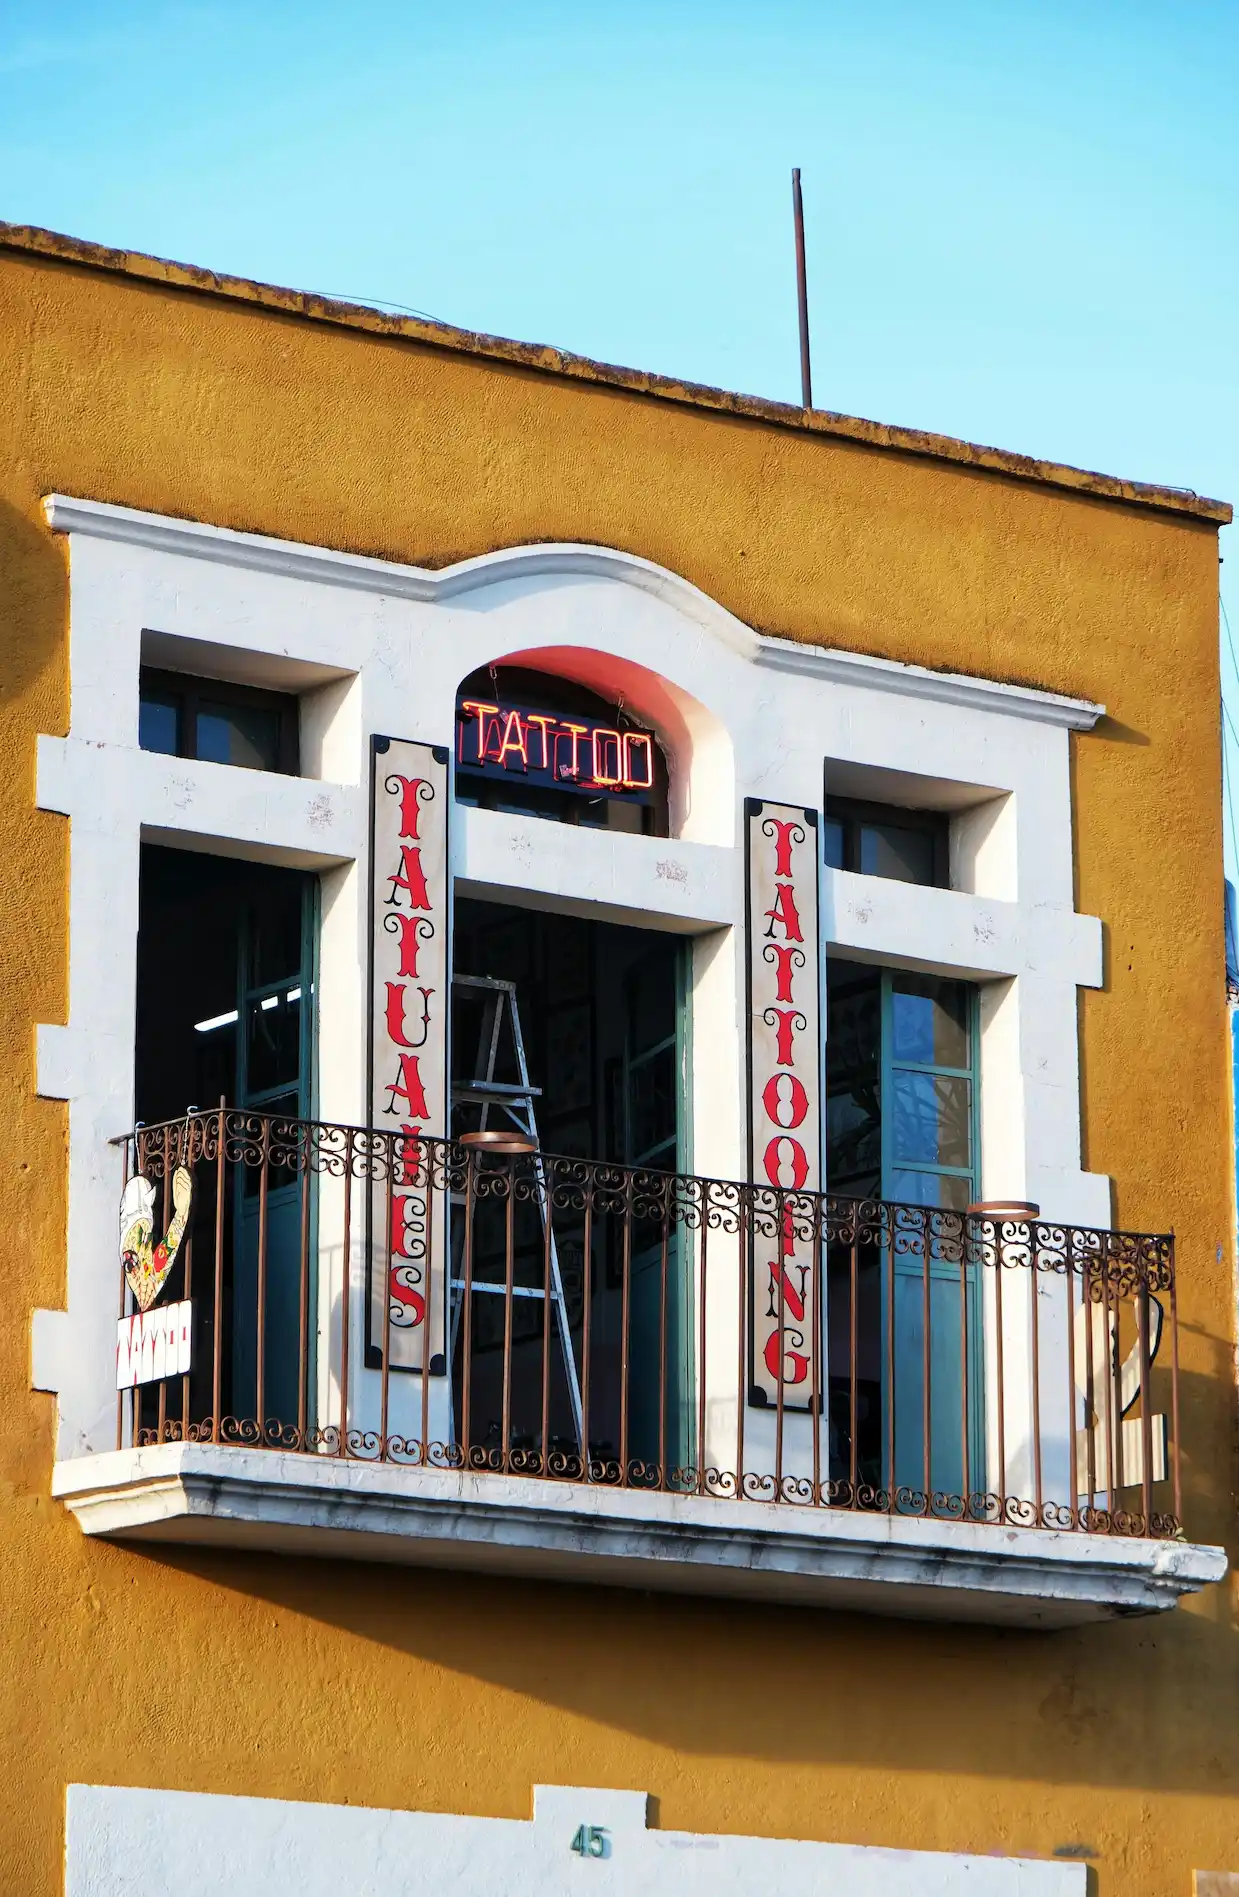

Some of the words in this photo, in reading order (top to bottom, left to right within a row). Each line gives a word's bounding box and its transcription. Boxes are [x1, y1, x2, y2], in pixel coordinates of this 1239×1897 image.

[461, 701, 653, 788] TATTOO
[117, 1300, 192, 1390] TATTOO
[570, 1824, 604, 1857] 45
